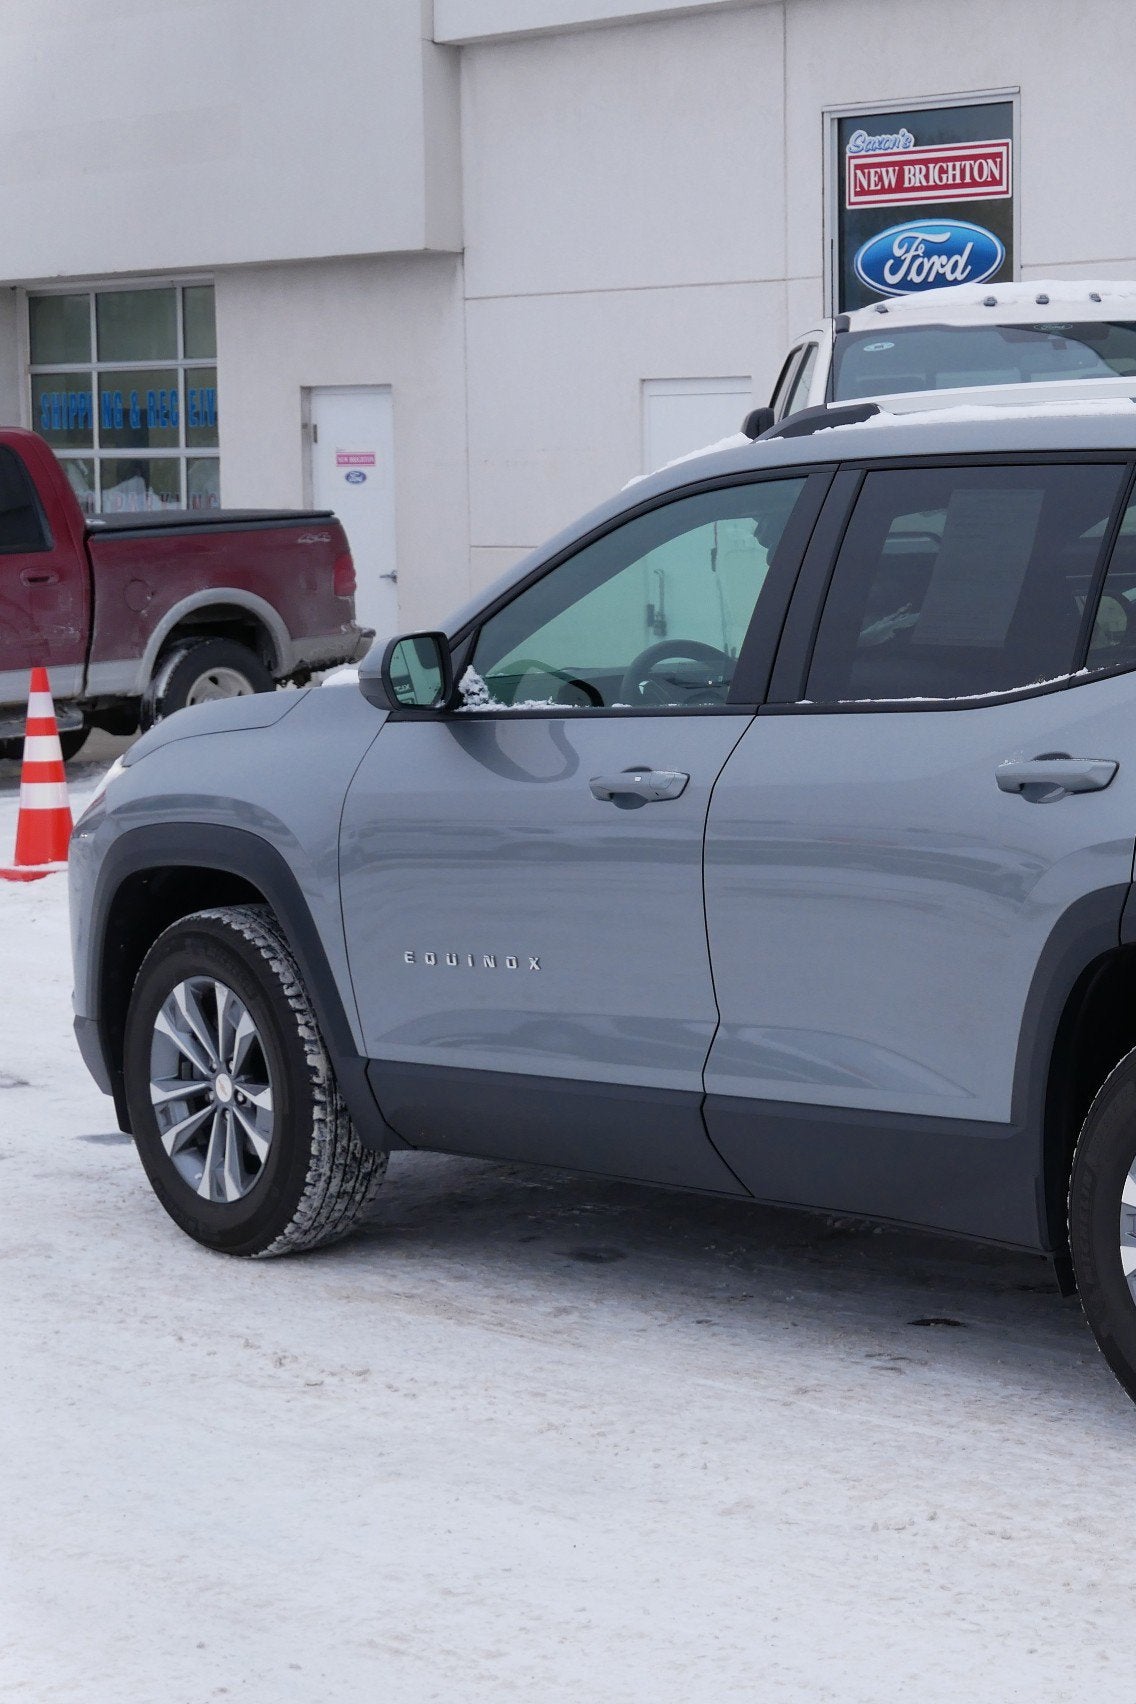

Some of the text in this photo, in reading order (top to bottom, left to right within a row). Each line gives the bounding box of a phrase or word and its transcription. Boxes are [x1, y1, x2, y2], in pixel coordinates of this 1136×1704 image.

[848, 131, 913, 153] Saxon's
[855, 158, 1001, 191] NEW BRIGHTON
[884, 231, 974, 285] Ford
[130, 389, 141, 429] &
[404, 951, 541, 970] EQUINOX
